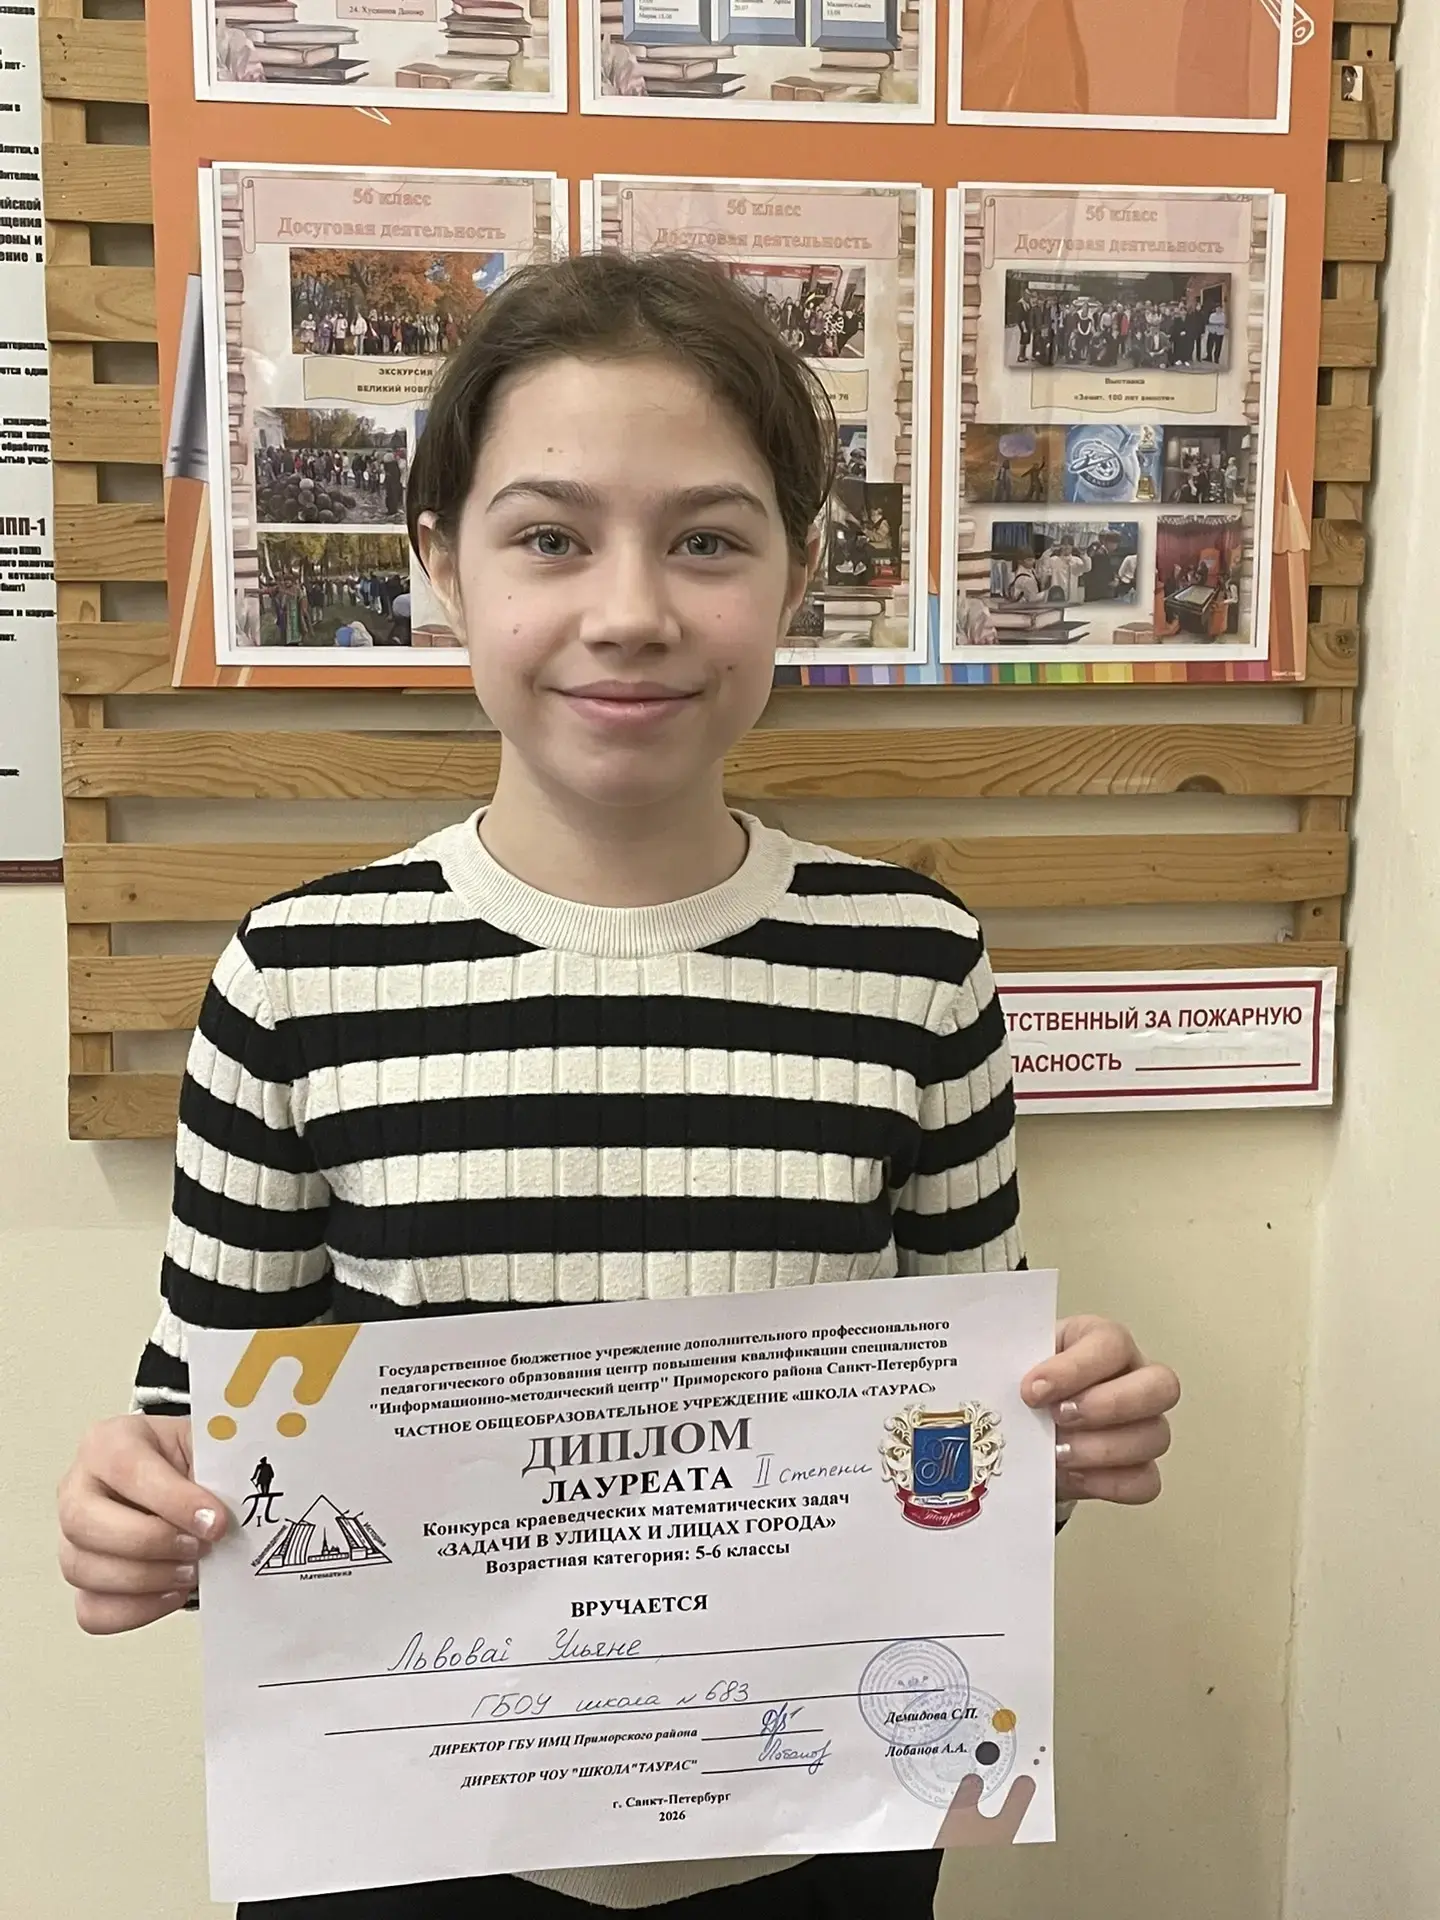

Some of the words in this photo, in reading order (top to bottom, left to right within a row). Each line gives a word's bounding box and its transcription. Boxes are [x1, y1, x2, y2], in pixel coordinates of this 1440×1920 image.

[379, 193, 432, 206] класс
[752, 204, 802, 217] класс
[1109, 208, 1158, 222] класс
[278, 217, 376, 239] Досуговая
[380, 224, 506, 240] деятельность
[34, 236, 42, 246] и
[752, 233, 872, 249] деятельность
[1108, 239, 1225, 254] деятельность
[35, 253, 43, 263] в
[378, 368, 433, 376] ЭКСКУРСИЯ
[357, 384, 401, 392] ВЕЛИКИЙ
[1145, 1009, 1172, 1028] ЗА
[1178, 1006, 1303, 1028] ПОЖАРНУЮ
[379, 1356, 507, 1378] Государственное
[510, 1349, 592, 1366] бюджетное
[595, 1341, 681, 1359] учреждение
[684, 1329, 808, 1351] дополнительного
[811, 1318, 950, 1341] профессионального
[380, 1374, 505, 1397] педагогического
[509, 1368, 601, 1386] образования
[606, 1360, 648, 1378] центр
[652, 1355, 737, 1372] повышения
[741, 1346, 848, 1364] квалификации
[851, 1338, 948, 1358] специалистов
[369, 1382, 614, 1416] "Информационно-методический
[618, 1377, 669, 1395] центр"
[673, 1368, 769, 1389] Приморского
[773, 1364, 823, 1380] района
[826, 1355, 958, 1377] Санкт-Петербурга
[394, 1420, 472, 1438] ЧАСТНОЕ
[475, 1400, 679, 1430] ОБЩЕОБРАЗОВАТЕЛЬНОЕ
[683, 1391, 788, 1412] УЧРЕЖДЕНИЕ
[792, 1386, 858, 1402] «ШКОЛА
[521, 1417, 752, 1478] ДИПЛОМ
[542, 1466, 733, 1504] ЛАУРЕАТА
[423, 1519, 510, 1537] Конкурса
[516, 1506, 646, 1531] краеведческих
[652, 1496, 797, 1517] математических
[802, 1493, 850, 1508] задач
[437, 1535, 531, 1558] «ЗАДАЧИ
[536, 1533, 549, 1548] В
[554, 1525, 641, 1546] УЛИЦАХ
[648, 1525, 662, 1540] И
[667, 1520, 740, 1539] ЛИЦАХ
[745, 1514, 837, 1534] ГОРОДА»
[485, 1555, 588, 1575] Возрастная
[593, 1546, 690, 1567] категория:
[695, 1543, 722, 1560] 5-6
[727, 1542, 791, 1558] классы
[300, 1570, 352, 1581] Математика
[571, 1595, 709, 1618] ВРУЧАЕТСЯ
[470, 1694, 552, 1719] ГБОУ
[704, 1680, 750, 1702] 683
[884, 1711, 947, 1725] Демидова
[951, 1707, 979, 1721] С.П.
[429, 1741, 505, 1758] ДИРЕКТОР
[507, 1738, 535, 1752] ГБУ
[537, 1734, 571, 1750] ИМЦ
[574, 1731, 652, 1748] Приморского
[655, 1727, 698, 1742] района
[885, 1744, 939, 1758] Лобанов
[460, 1771, 536, 1789] ДИРЕКТОР
[538, 1768, 569, 1783] ЧОУ
[612, 1799, 622, 1809] г.
[625, 1792, 731, 1809] Санкт-Петербург
[658, 1809, 686, 1822] 2026
